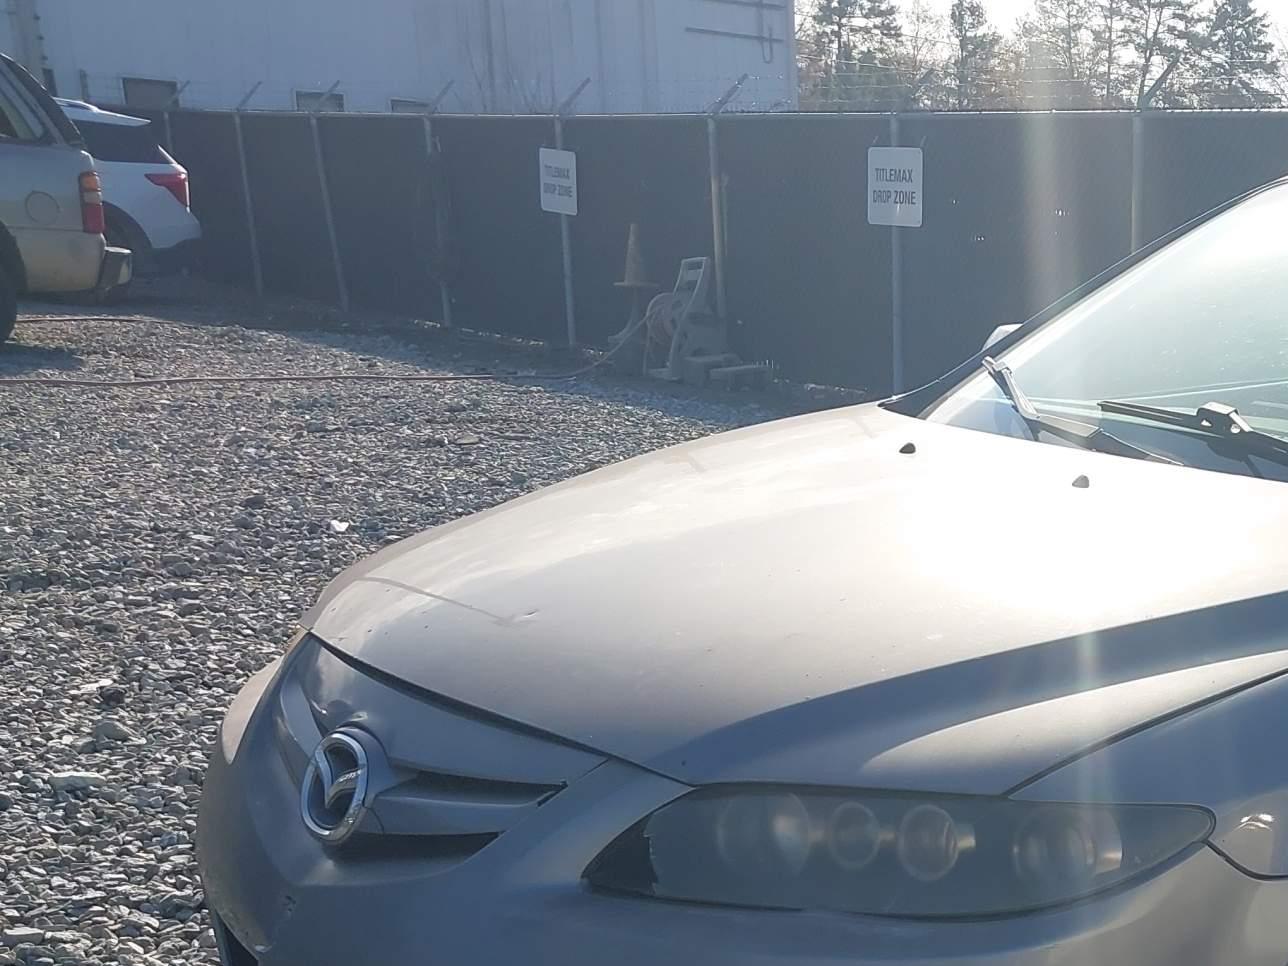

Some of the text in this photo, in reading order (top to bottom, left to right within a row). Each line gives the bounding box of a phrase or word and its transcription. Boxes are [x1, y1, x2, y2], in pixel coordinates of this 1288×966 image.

[875, 168, 913, 183] TITLEMAX
[873, 190, 917, 205] DROP ZONE
